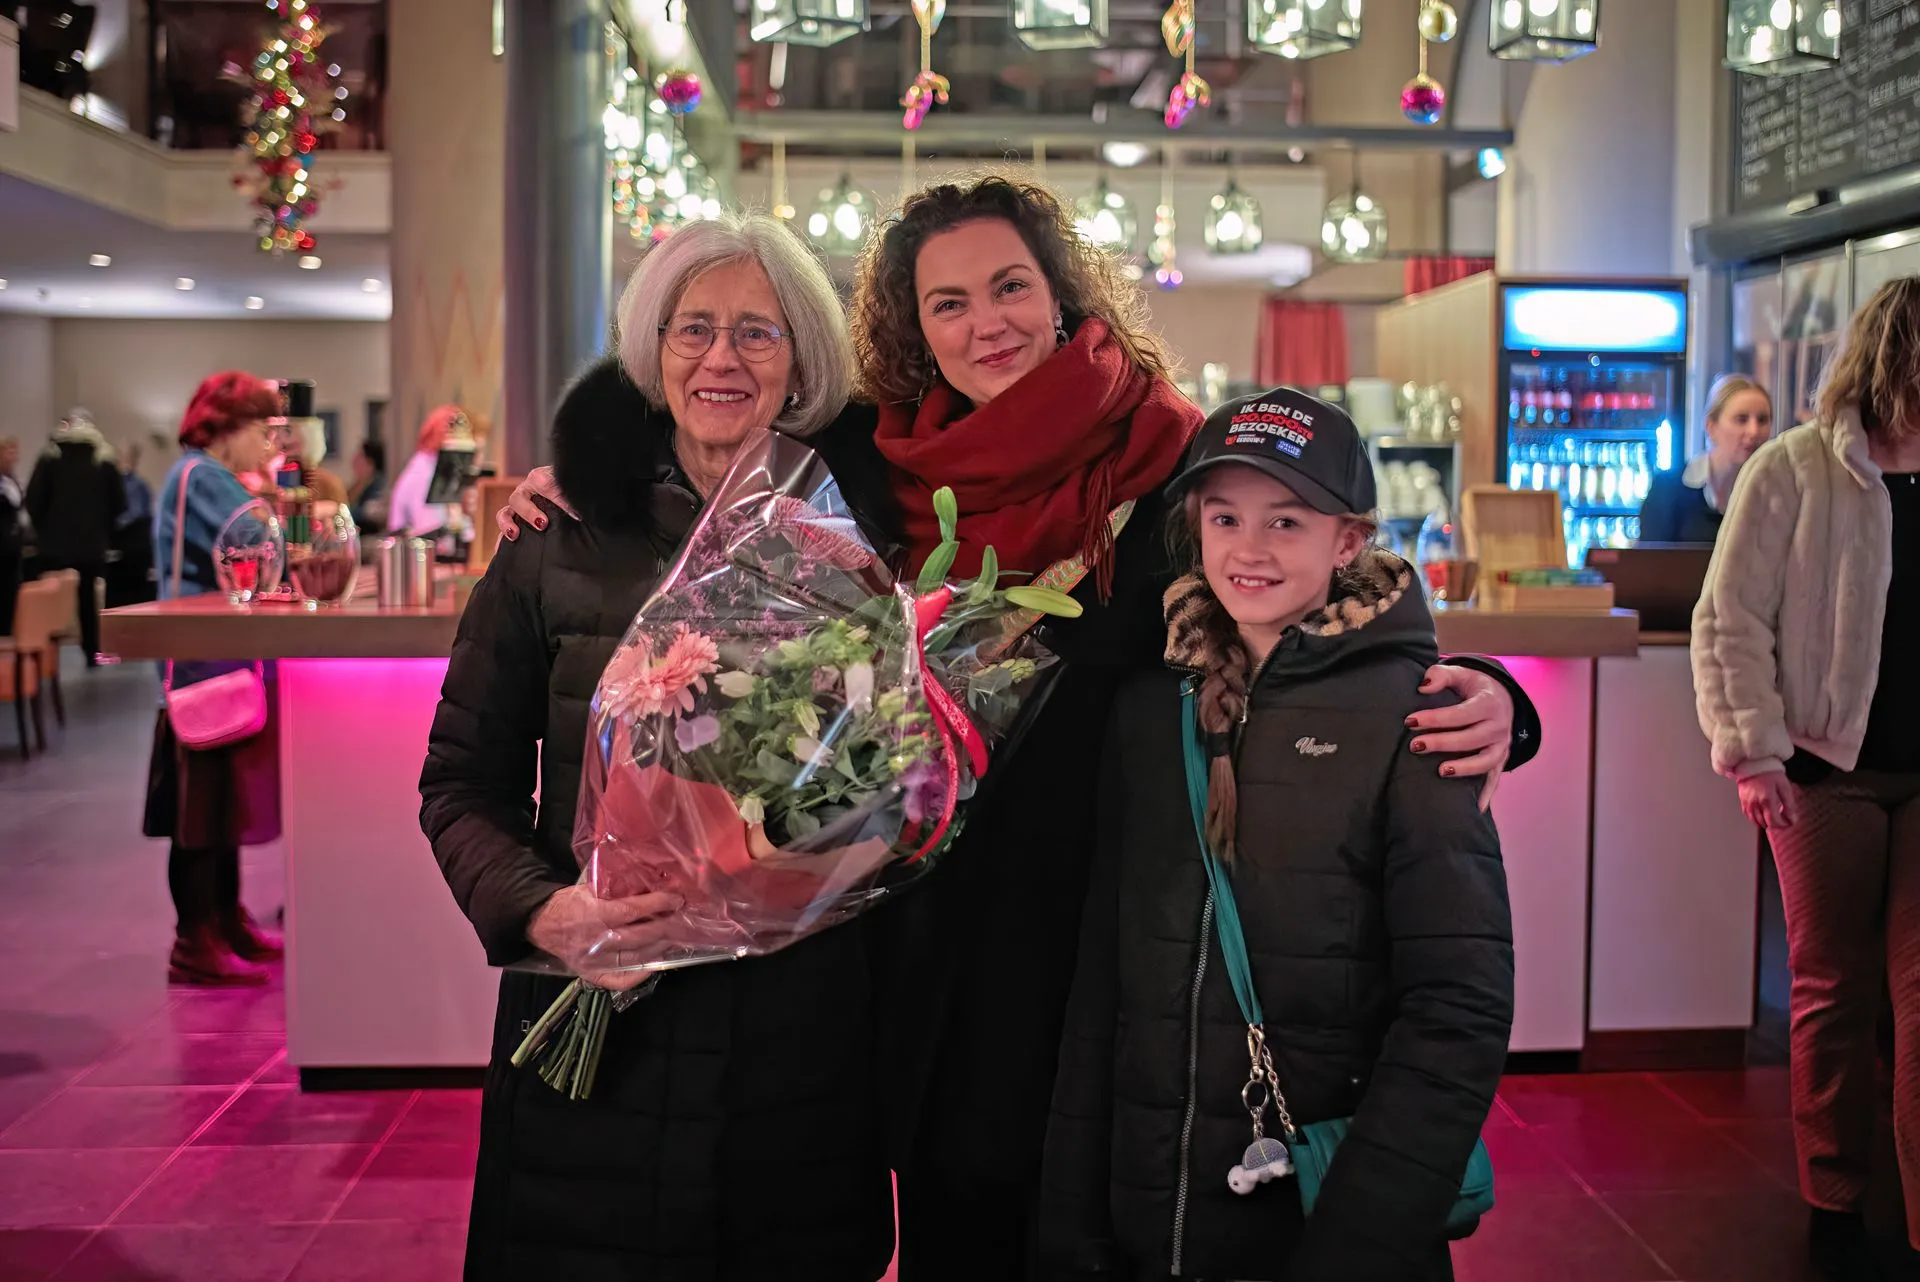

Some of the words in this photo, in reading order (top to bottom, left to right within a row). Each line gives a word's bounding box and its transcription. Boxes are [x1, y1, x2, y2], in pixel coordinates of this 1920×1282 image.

[1240, 403, 1257, 414] IK
[1257, 403, 1291, 416] BEN
[1292, 410, 1314, 426] DE
[1229, 422, 1308, 447] BEZOEKER
